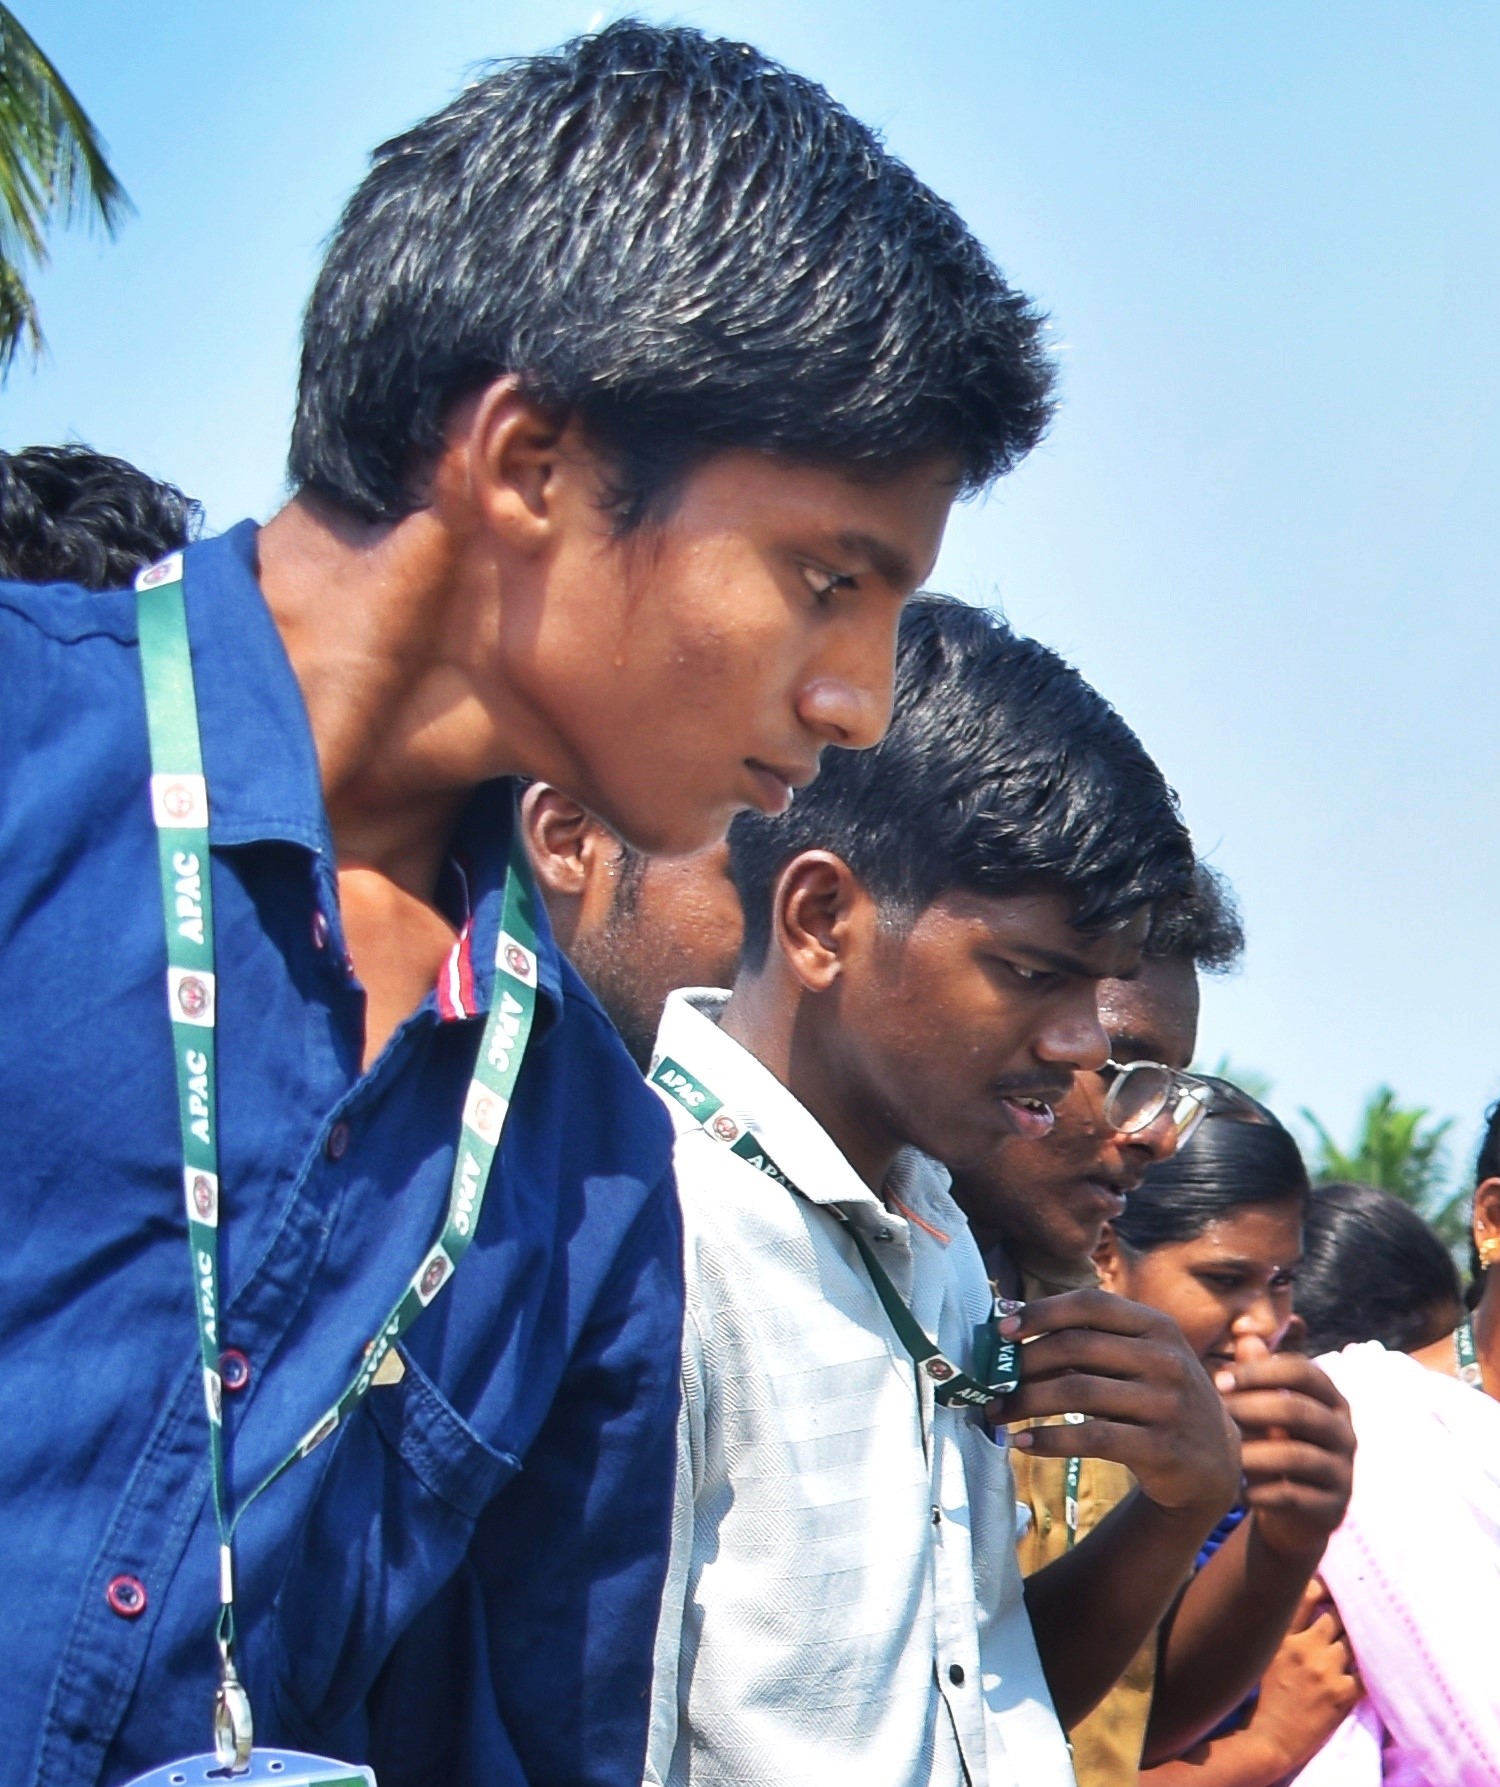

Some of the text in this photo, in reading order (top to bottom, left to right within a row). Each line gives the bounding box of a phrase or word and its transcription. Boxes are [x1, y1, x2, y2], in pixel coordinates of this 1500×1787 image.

[173, 852, 204, 945] APAC
[488, 991, 523, 1072] APAC
[186, 1049, 210, 1145] APAC
[659, 1069, 705, 1107] APAC
[456, 1152, 481, 1236] APAC
[198, 1251, 216, 1345] APAC
[357, 1314, 400, 1396] APAC
